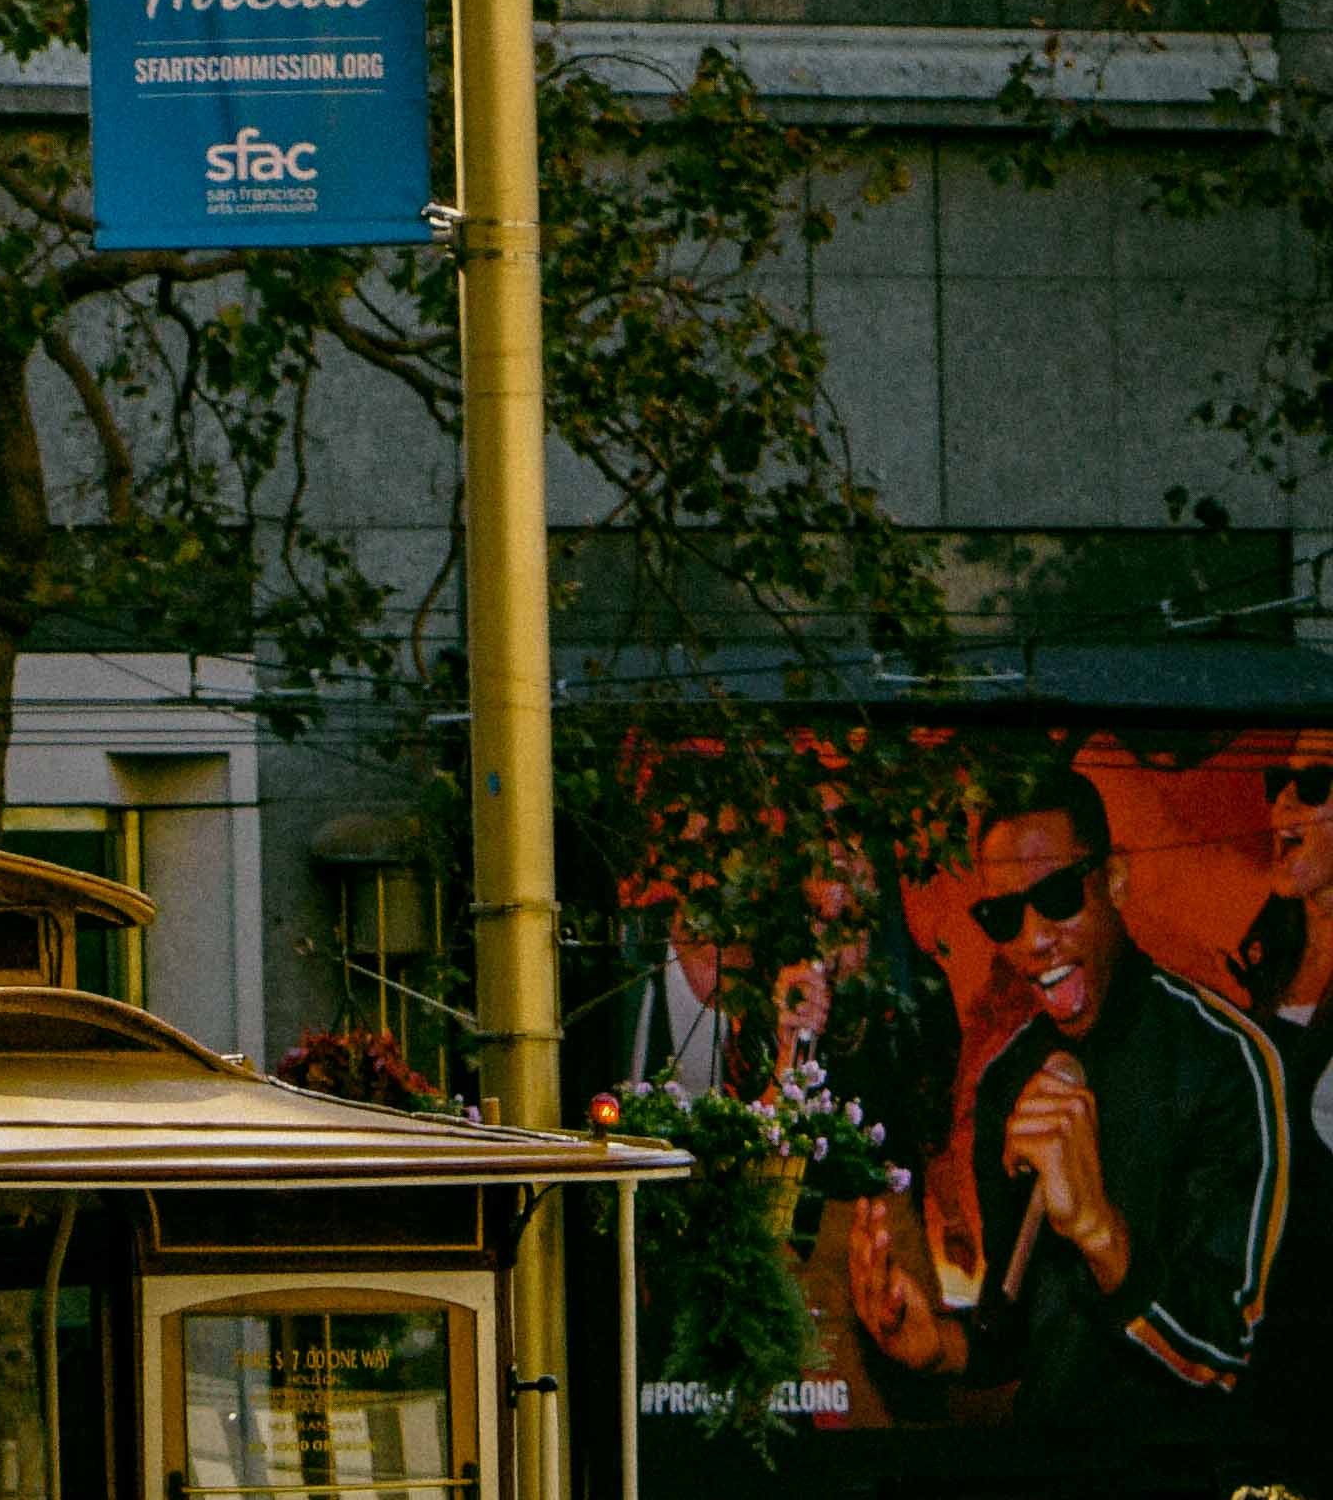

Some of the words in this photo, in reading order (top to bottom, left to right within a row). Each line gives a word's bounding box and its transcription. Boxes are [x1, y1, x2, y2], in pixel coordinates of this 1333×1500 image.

[135, 53, 384, 84] SFARTSCOMMISSION.ORG
[206, 127, 317, 182] sfac
[327, 1349, 358, 1369] ONE
[361, 1348, 391, 1369] WAY
